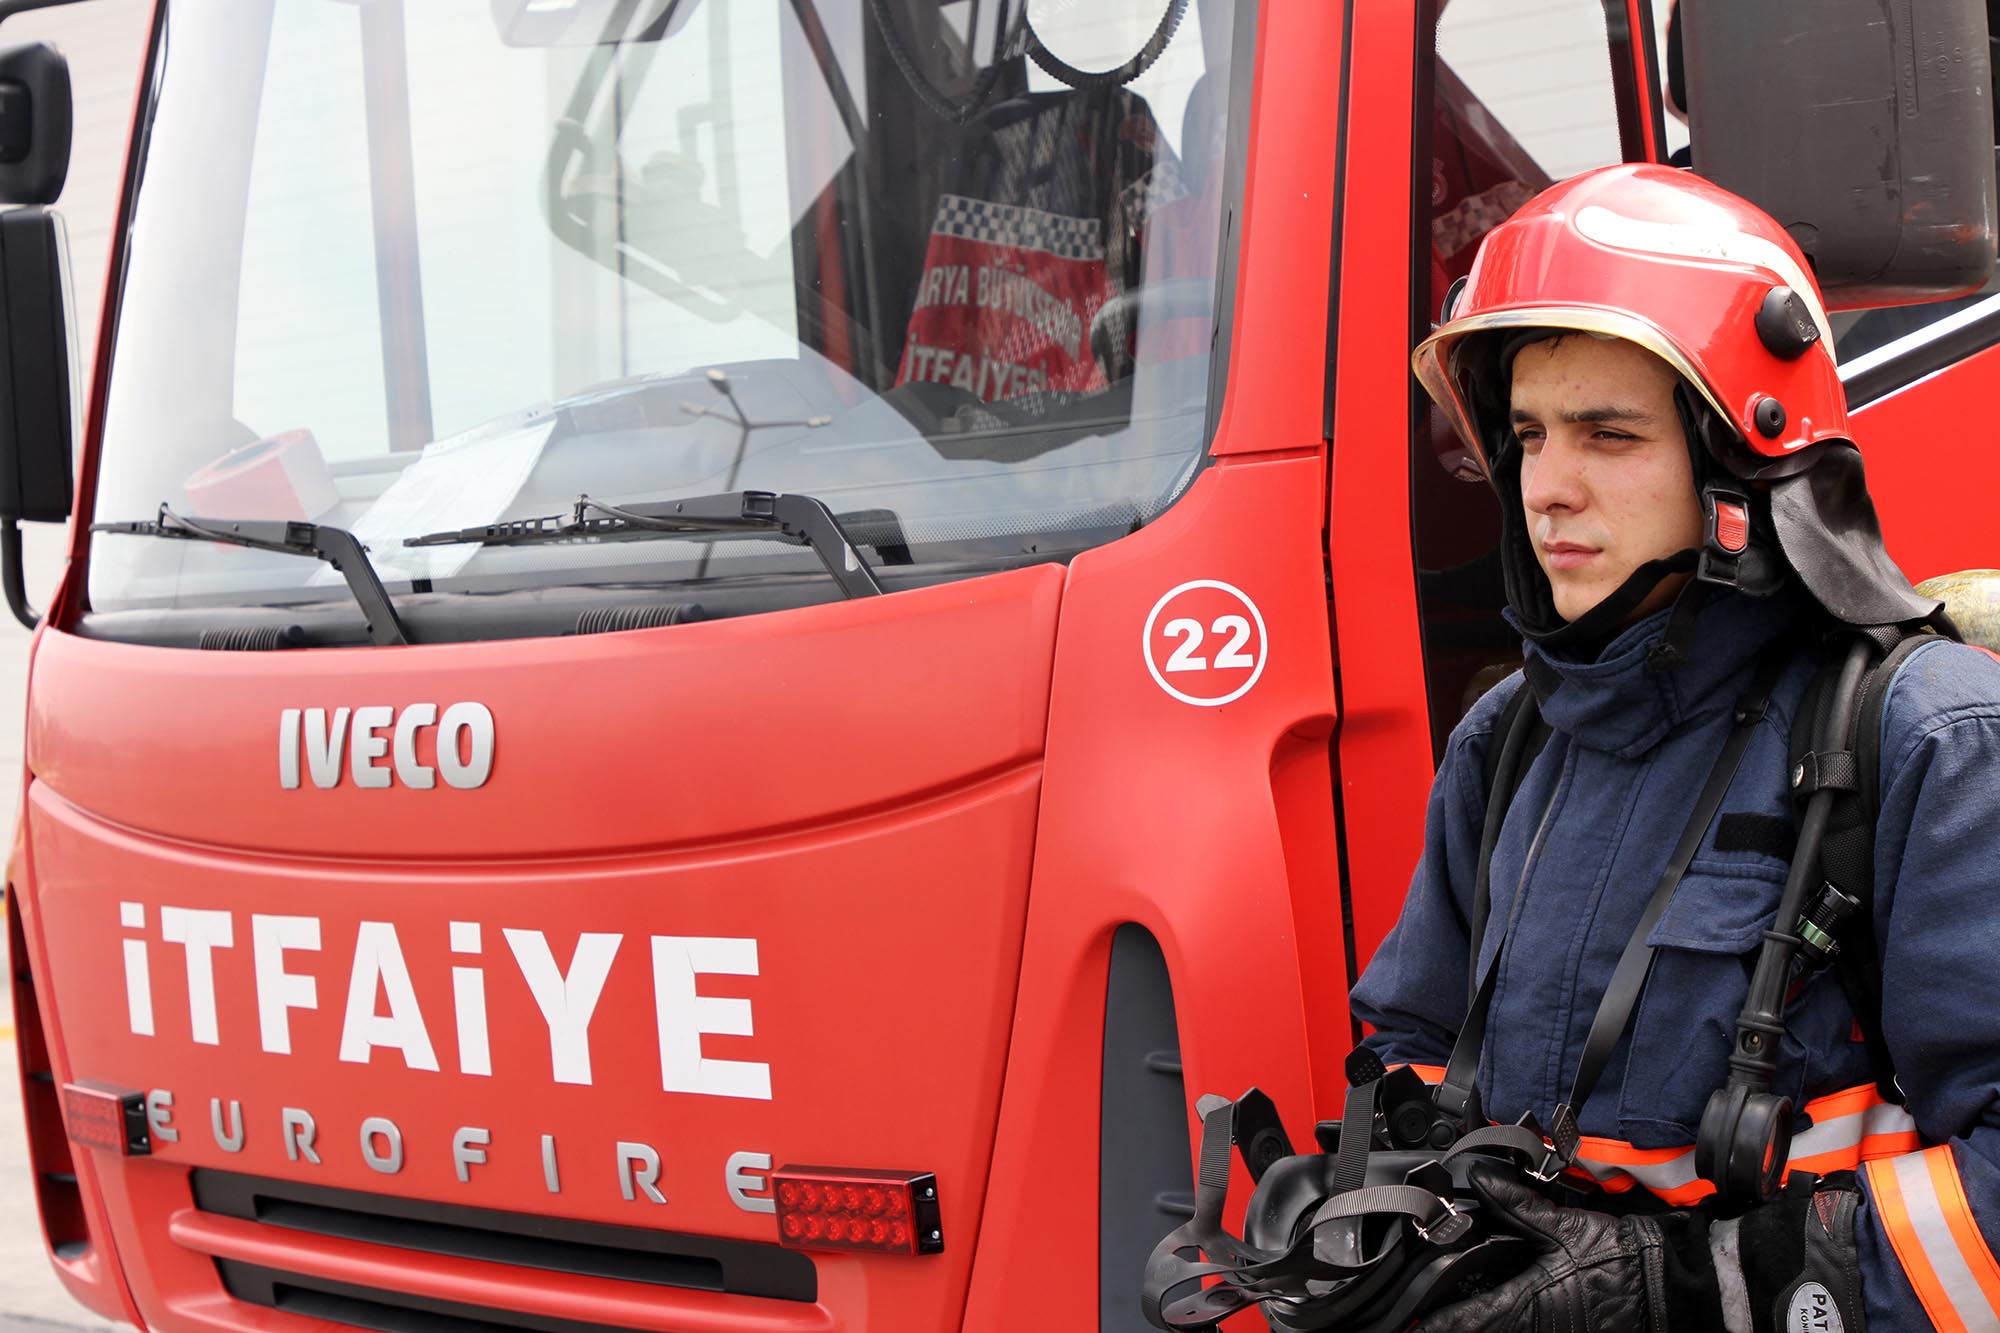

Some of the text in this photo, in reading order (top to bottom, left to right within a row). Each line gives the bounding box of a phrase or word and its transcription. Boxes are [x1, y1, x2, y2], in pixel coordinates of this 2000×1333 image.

[1163, 614, 1254, 673] 22
[279, 702, 496, 790] IVECO
[146, 1088, 776, 1213] EUROFIRE
